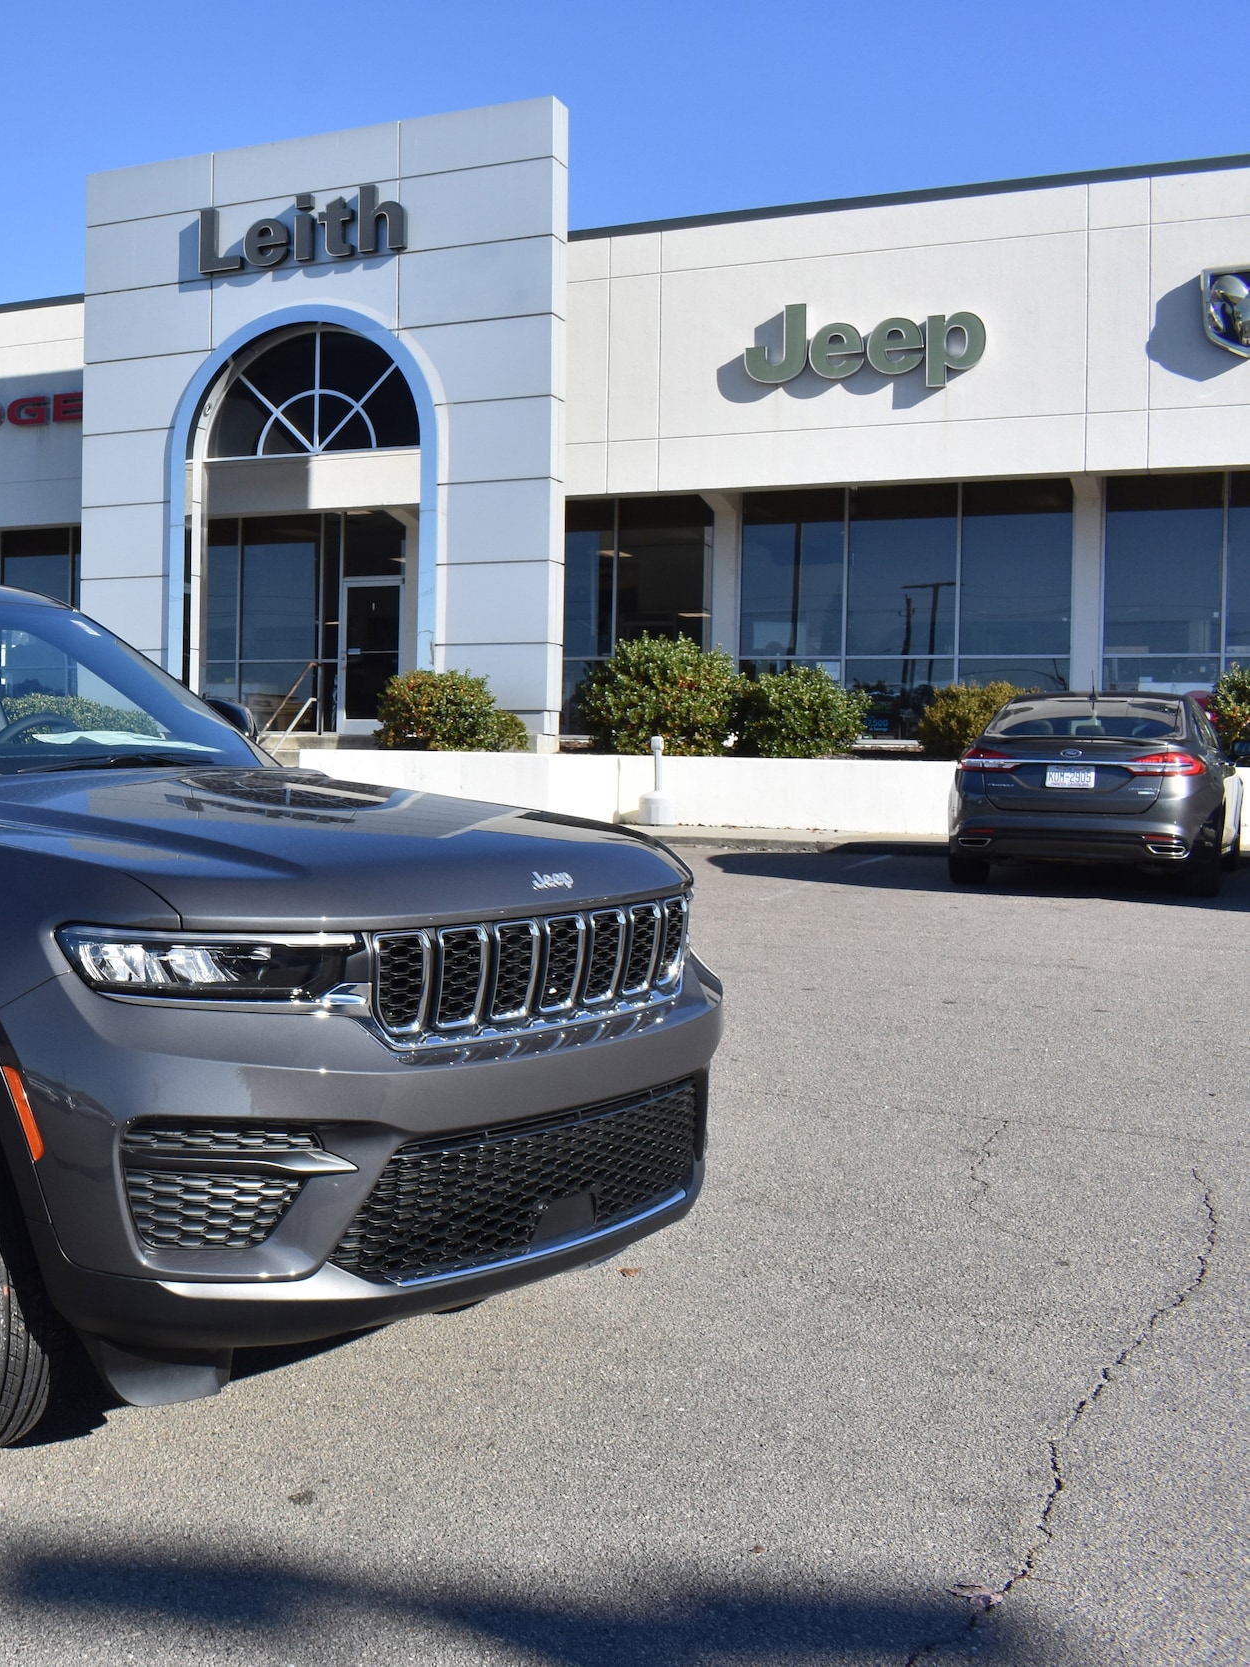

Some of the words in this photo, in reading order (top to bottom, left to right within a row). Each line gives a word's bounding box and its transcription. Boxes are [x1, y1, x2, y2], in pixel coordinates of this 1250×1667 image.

[199, 184, 407, 274] Leith
[744, 303, 987, 388] Jeep
[532, 871, 574, 890] Jeep
